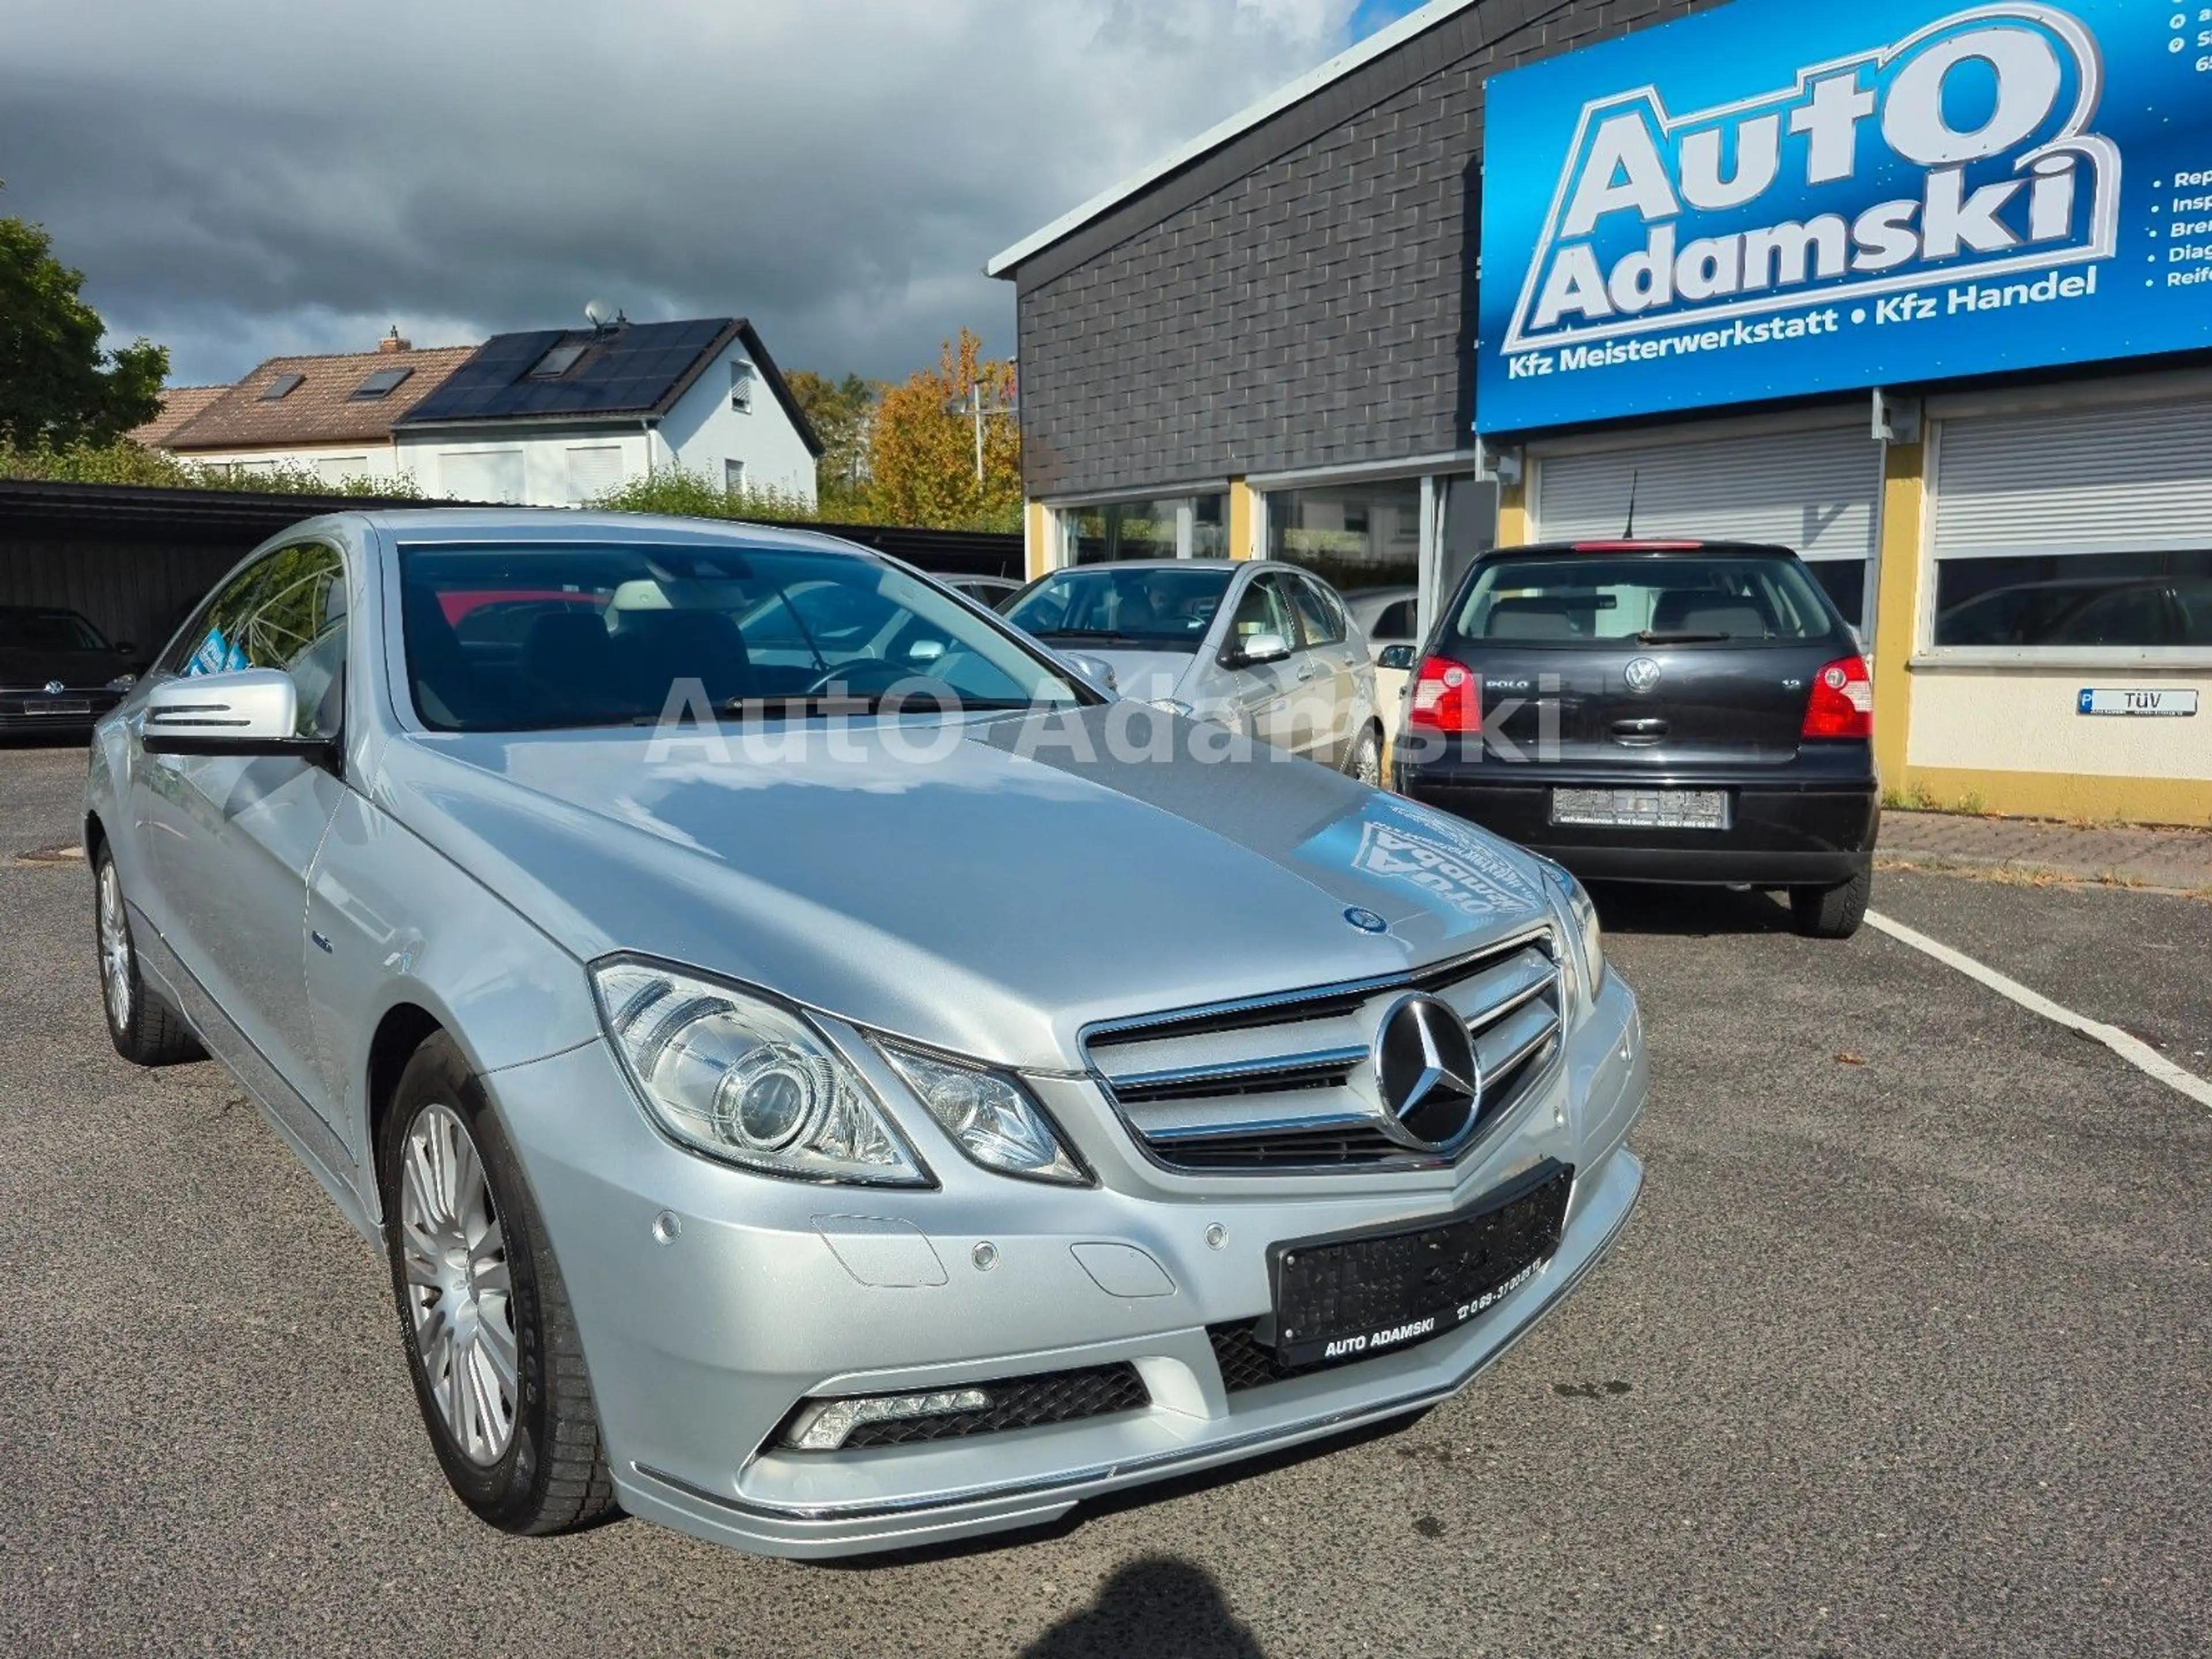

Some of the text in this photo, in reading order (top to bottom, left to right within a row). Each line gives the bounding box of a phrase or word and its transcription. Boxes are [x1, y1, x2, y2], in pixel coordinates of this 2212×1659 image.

[1530, 154, 2076, 328] Adamski
[1508, 266, 2096, 379] Kfz Meisterwerkstatt Kfz Handel
[1486, 680, 1529, 689] POLO
[1325, 1317, 1435, 1357] AUTO ADAMSKI
